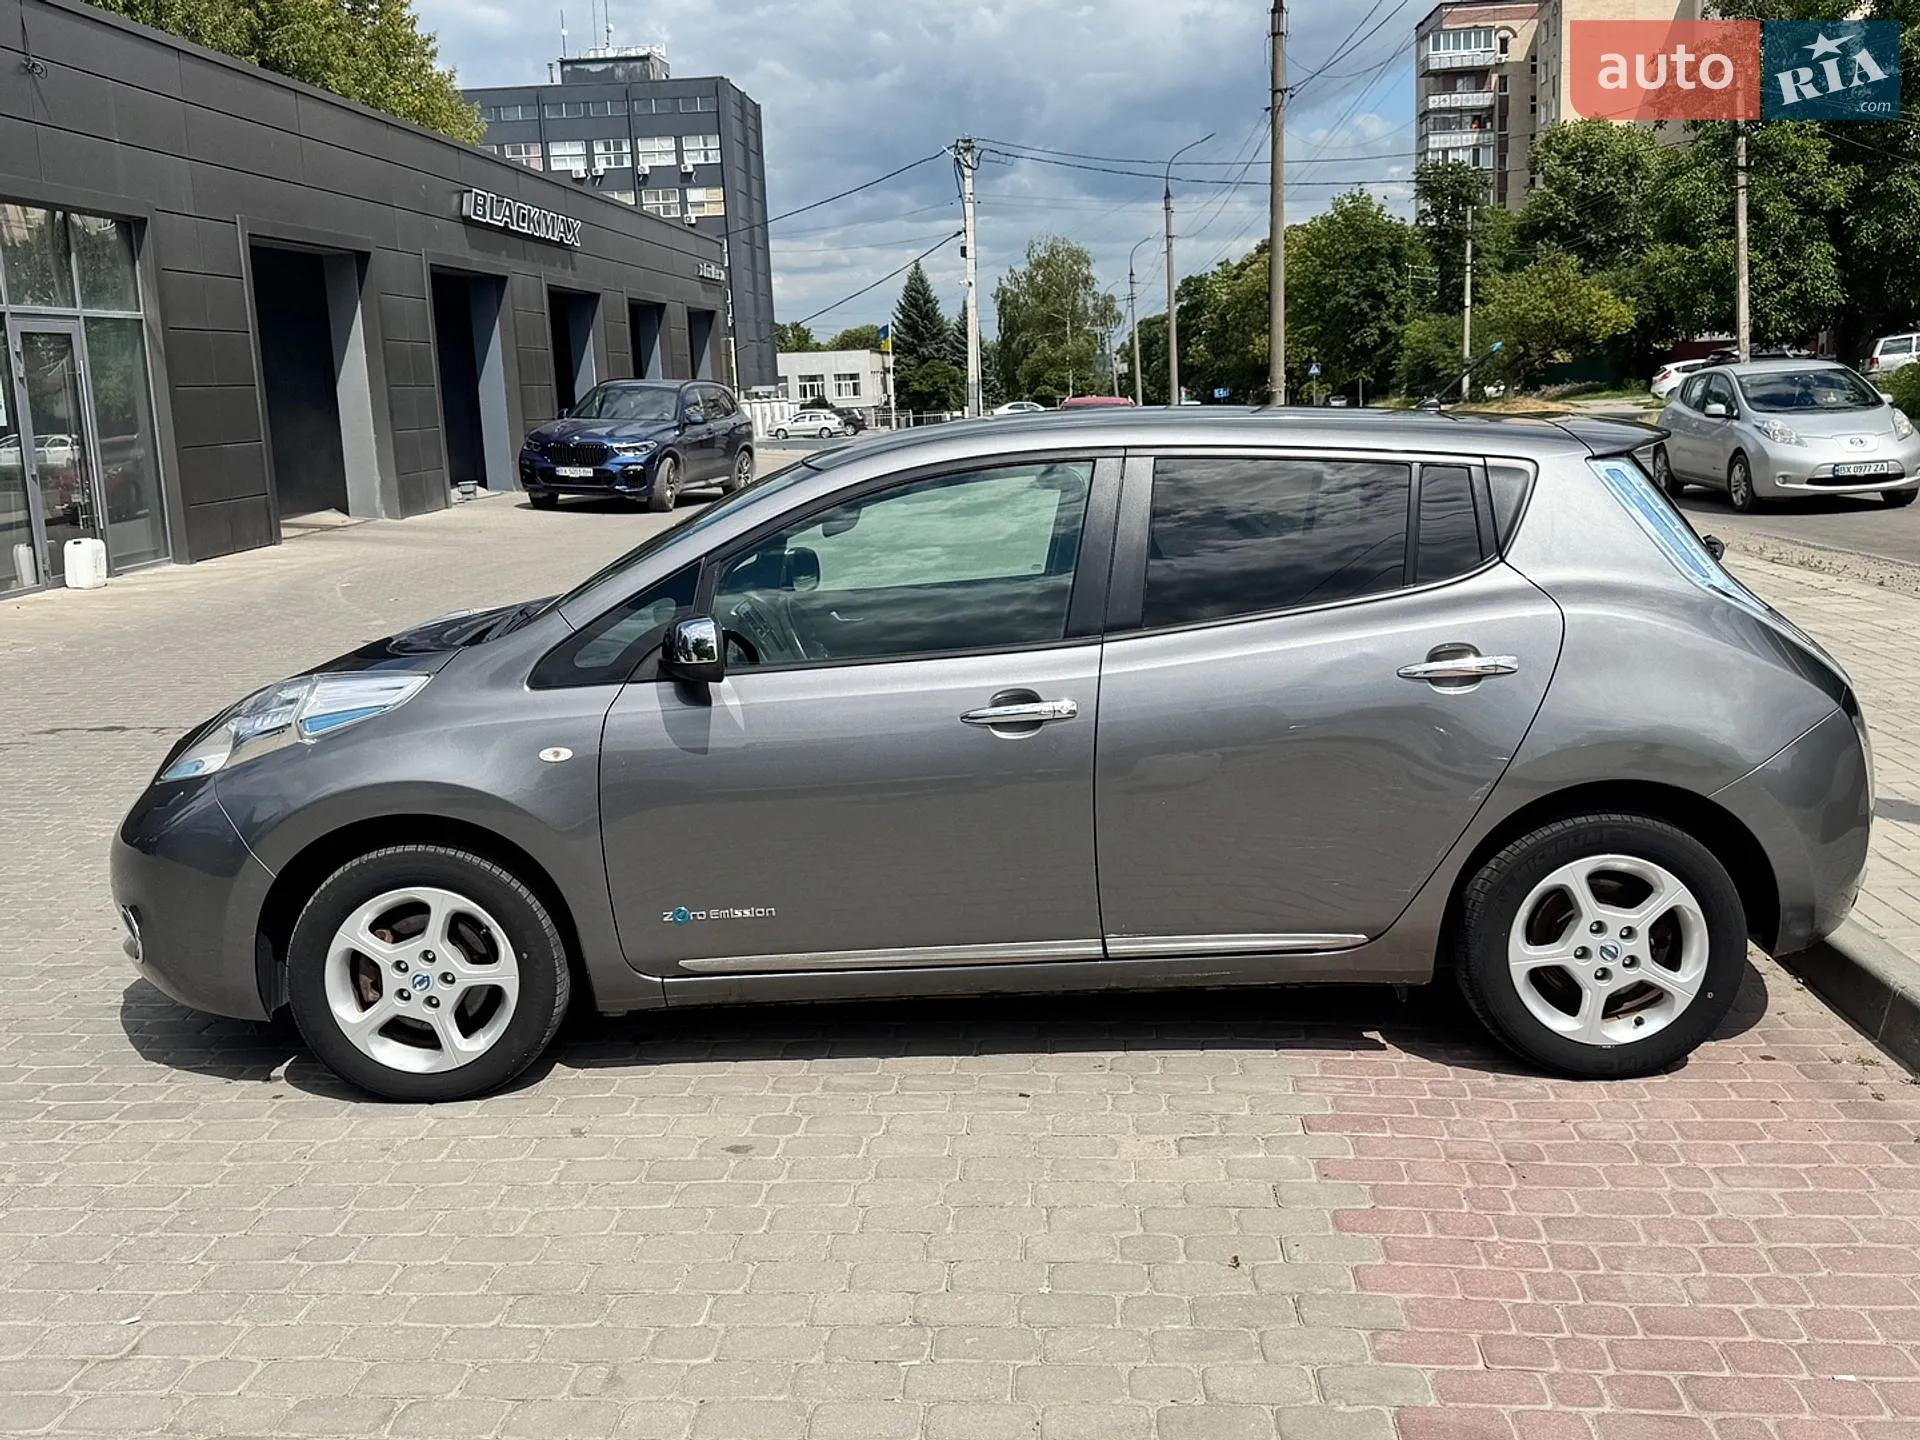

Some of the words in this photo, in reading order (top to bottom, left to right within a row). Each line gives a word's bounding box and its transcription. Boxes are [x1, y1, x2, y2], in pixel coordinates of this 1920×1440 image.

[471, 188, 581, 246] BLACKMAX
[1853, 465, 1872, 473] 0977
[1873, 464, 1885, 472] ZA
[709, 906, 777, 919] Emission
